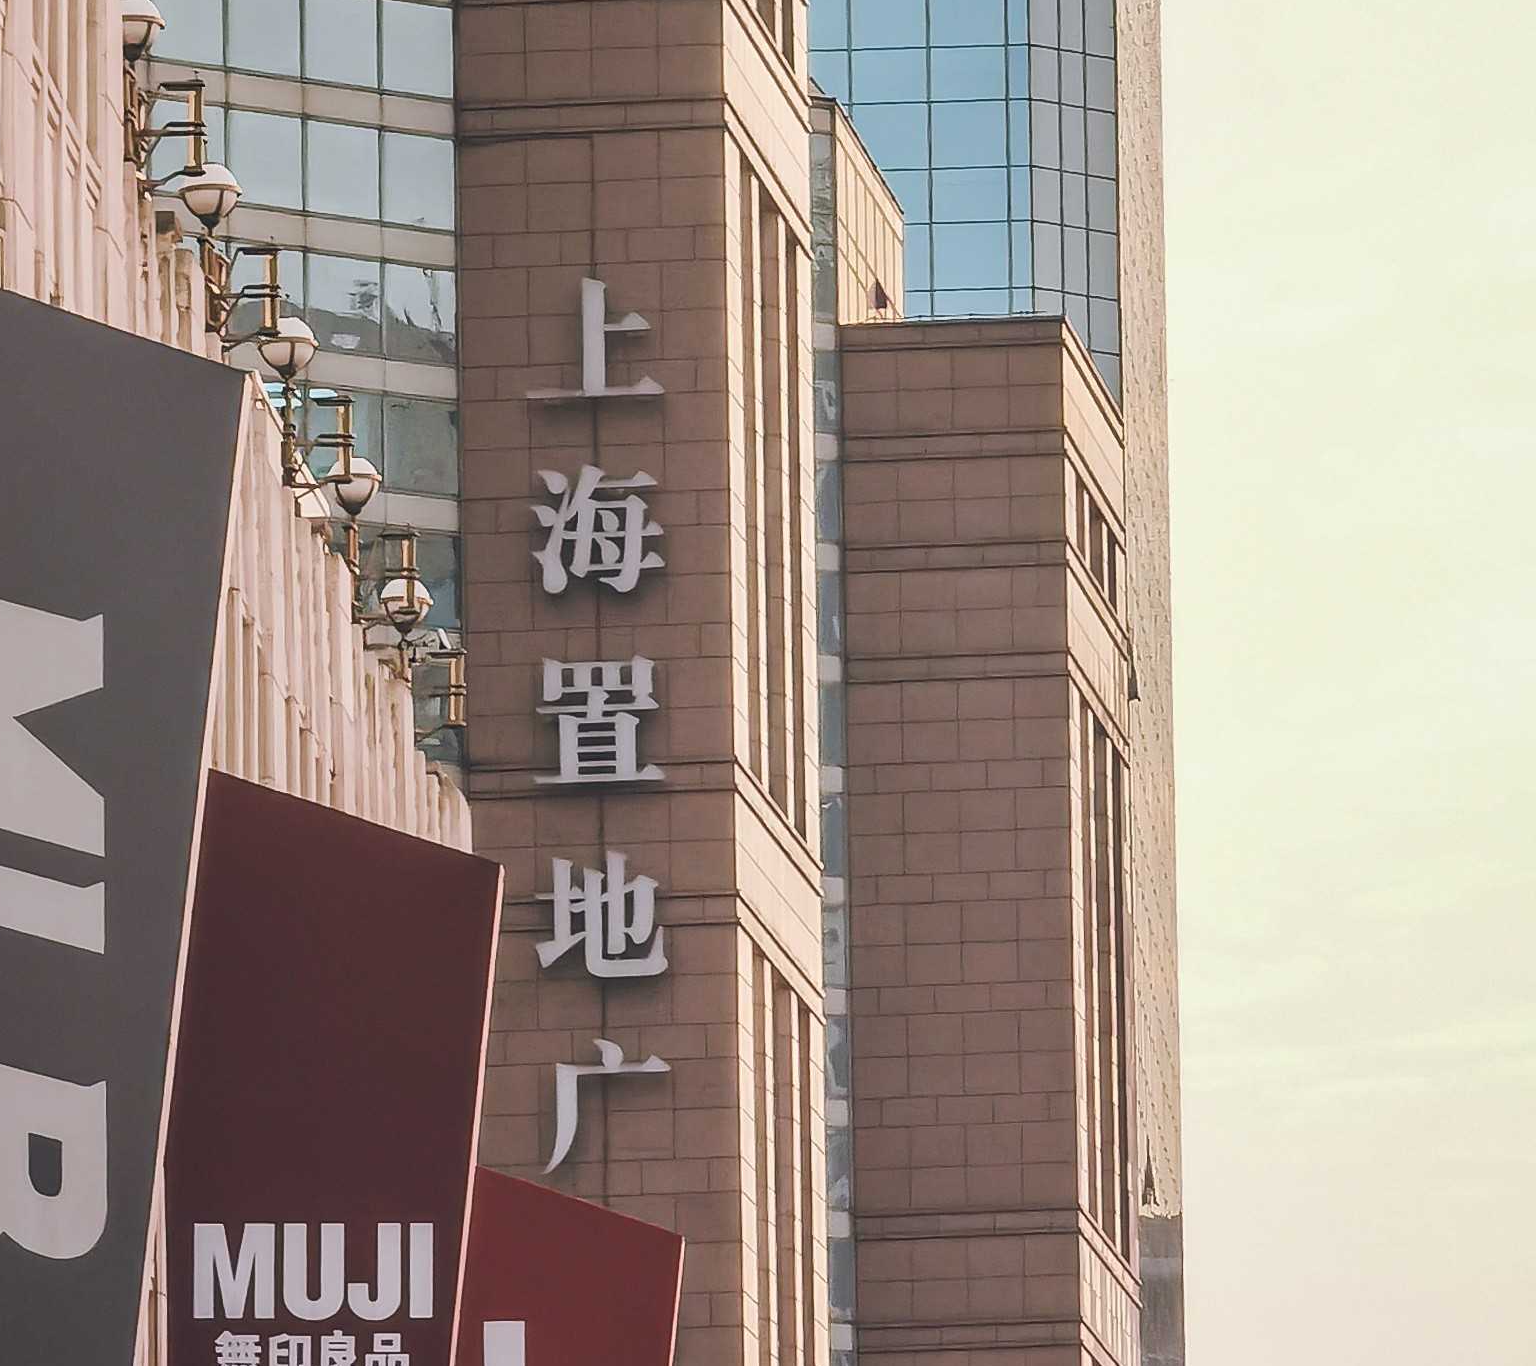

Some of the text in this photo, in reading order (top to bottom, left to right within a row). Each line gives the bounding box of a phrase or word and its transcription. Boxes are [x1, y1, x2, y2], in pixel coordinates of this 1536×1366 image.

[526, 277, 672, 1172] 上海置地广
[194, 1223, 433, 1320] MUJI
